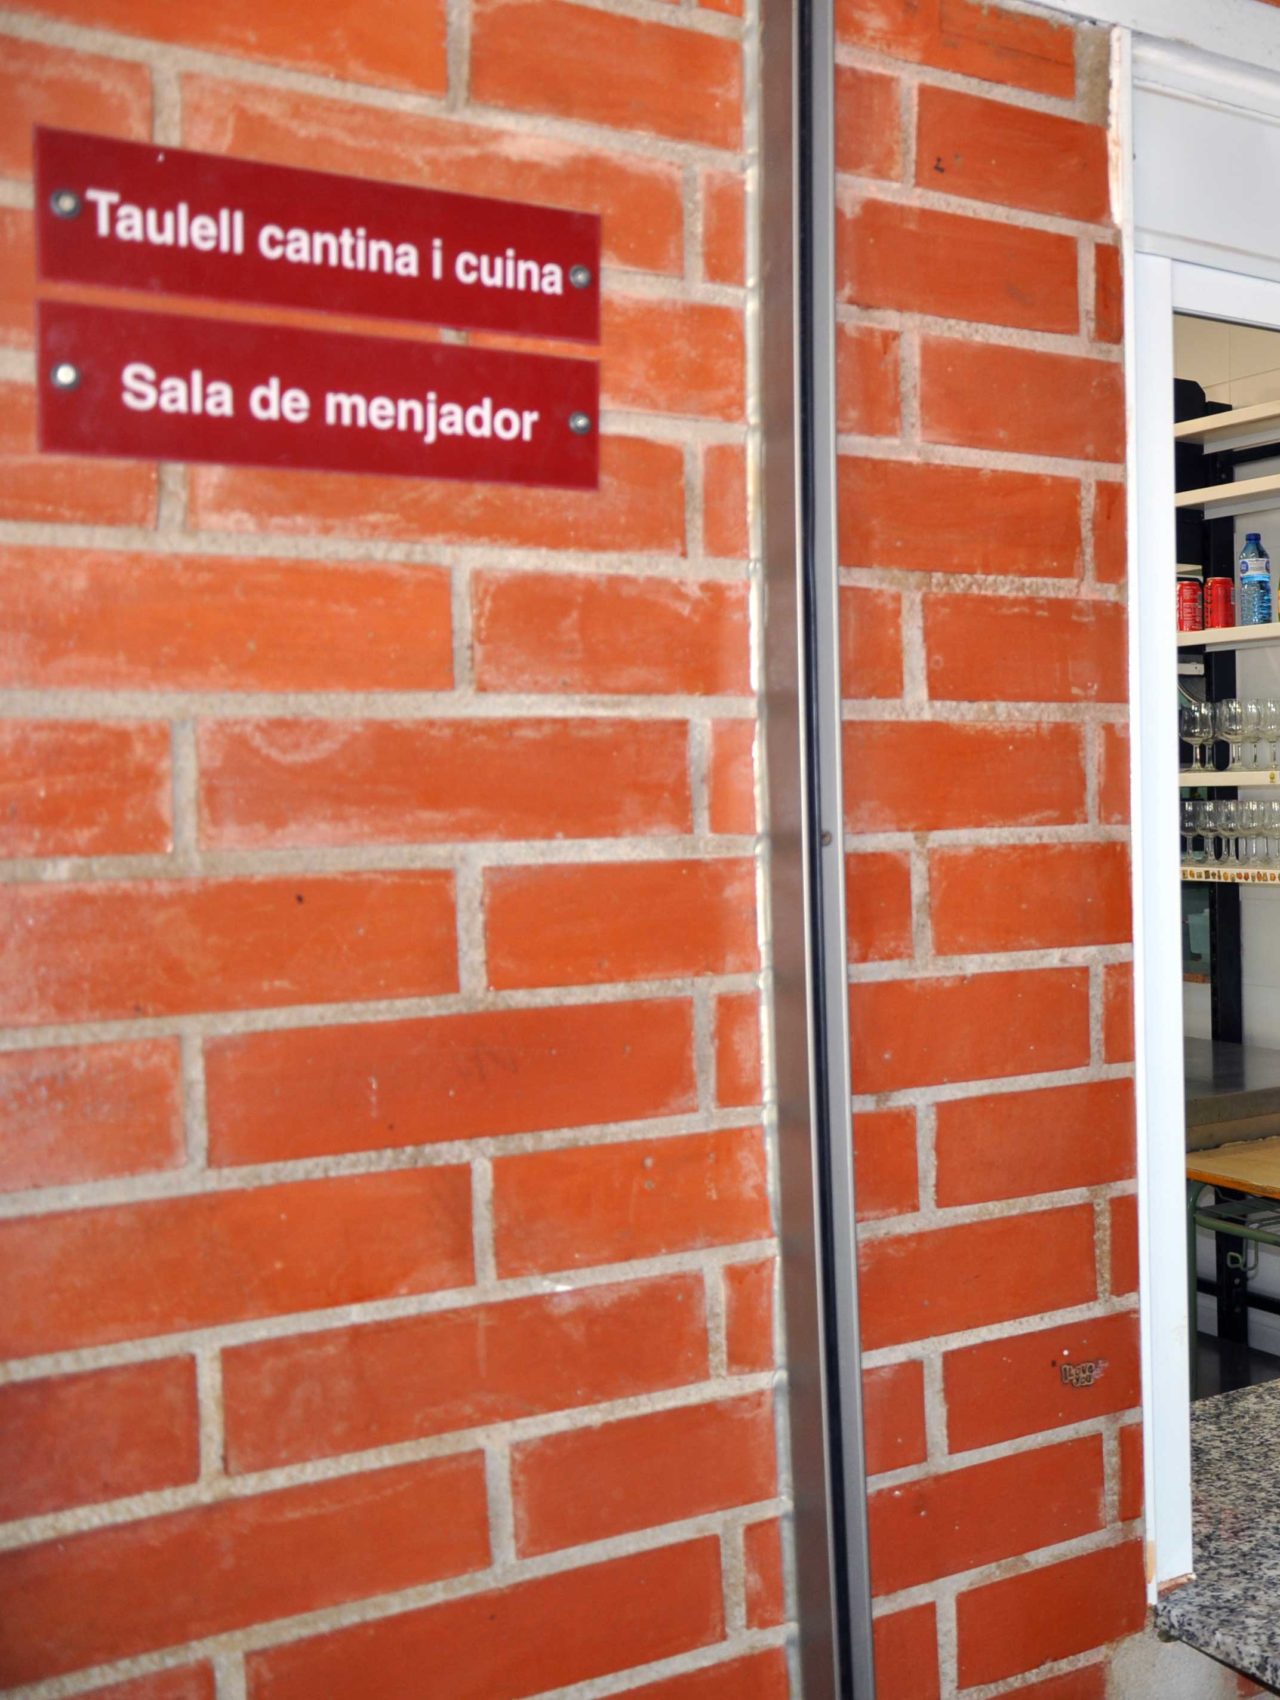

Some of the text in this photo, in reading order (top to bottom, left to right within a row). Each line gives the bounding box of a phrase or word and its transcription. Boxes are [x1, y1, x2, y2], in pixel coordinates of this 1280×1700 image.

[85, 188, 563, 295] Taulell cantina i cuina
[121, 362, 539, 444] Sala de menjador
